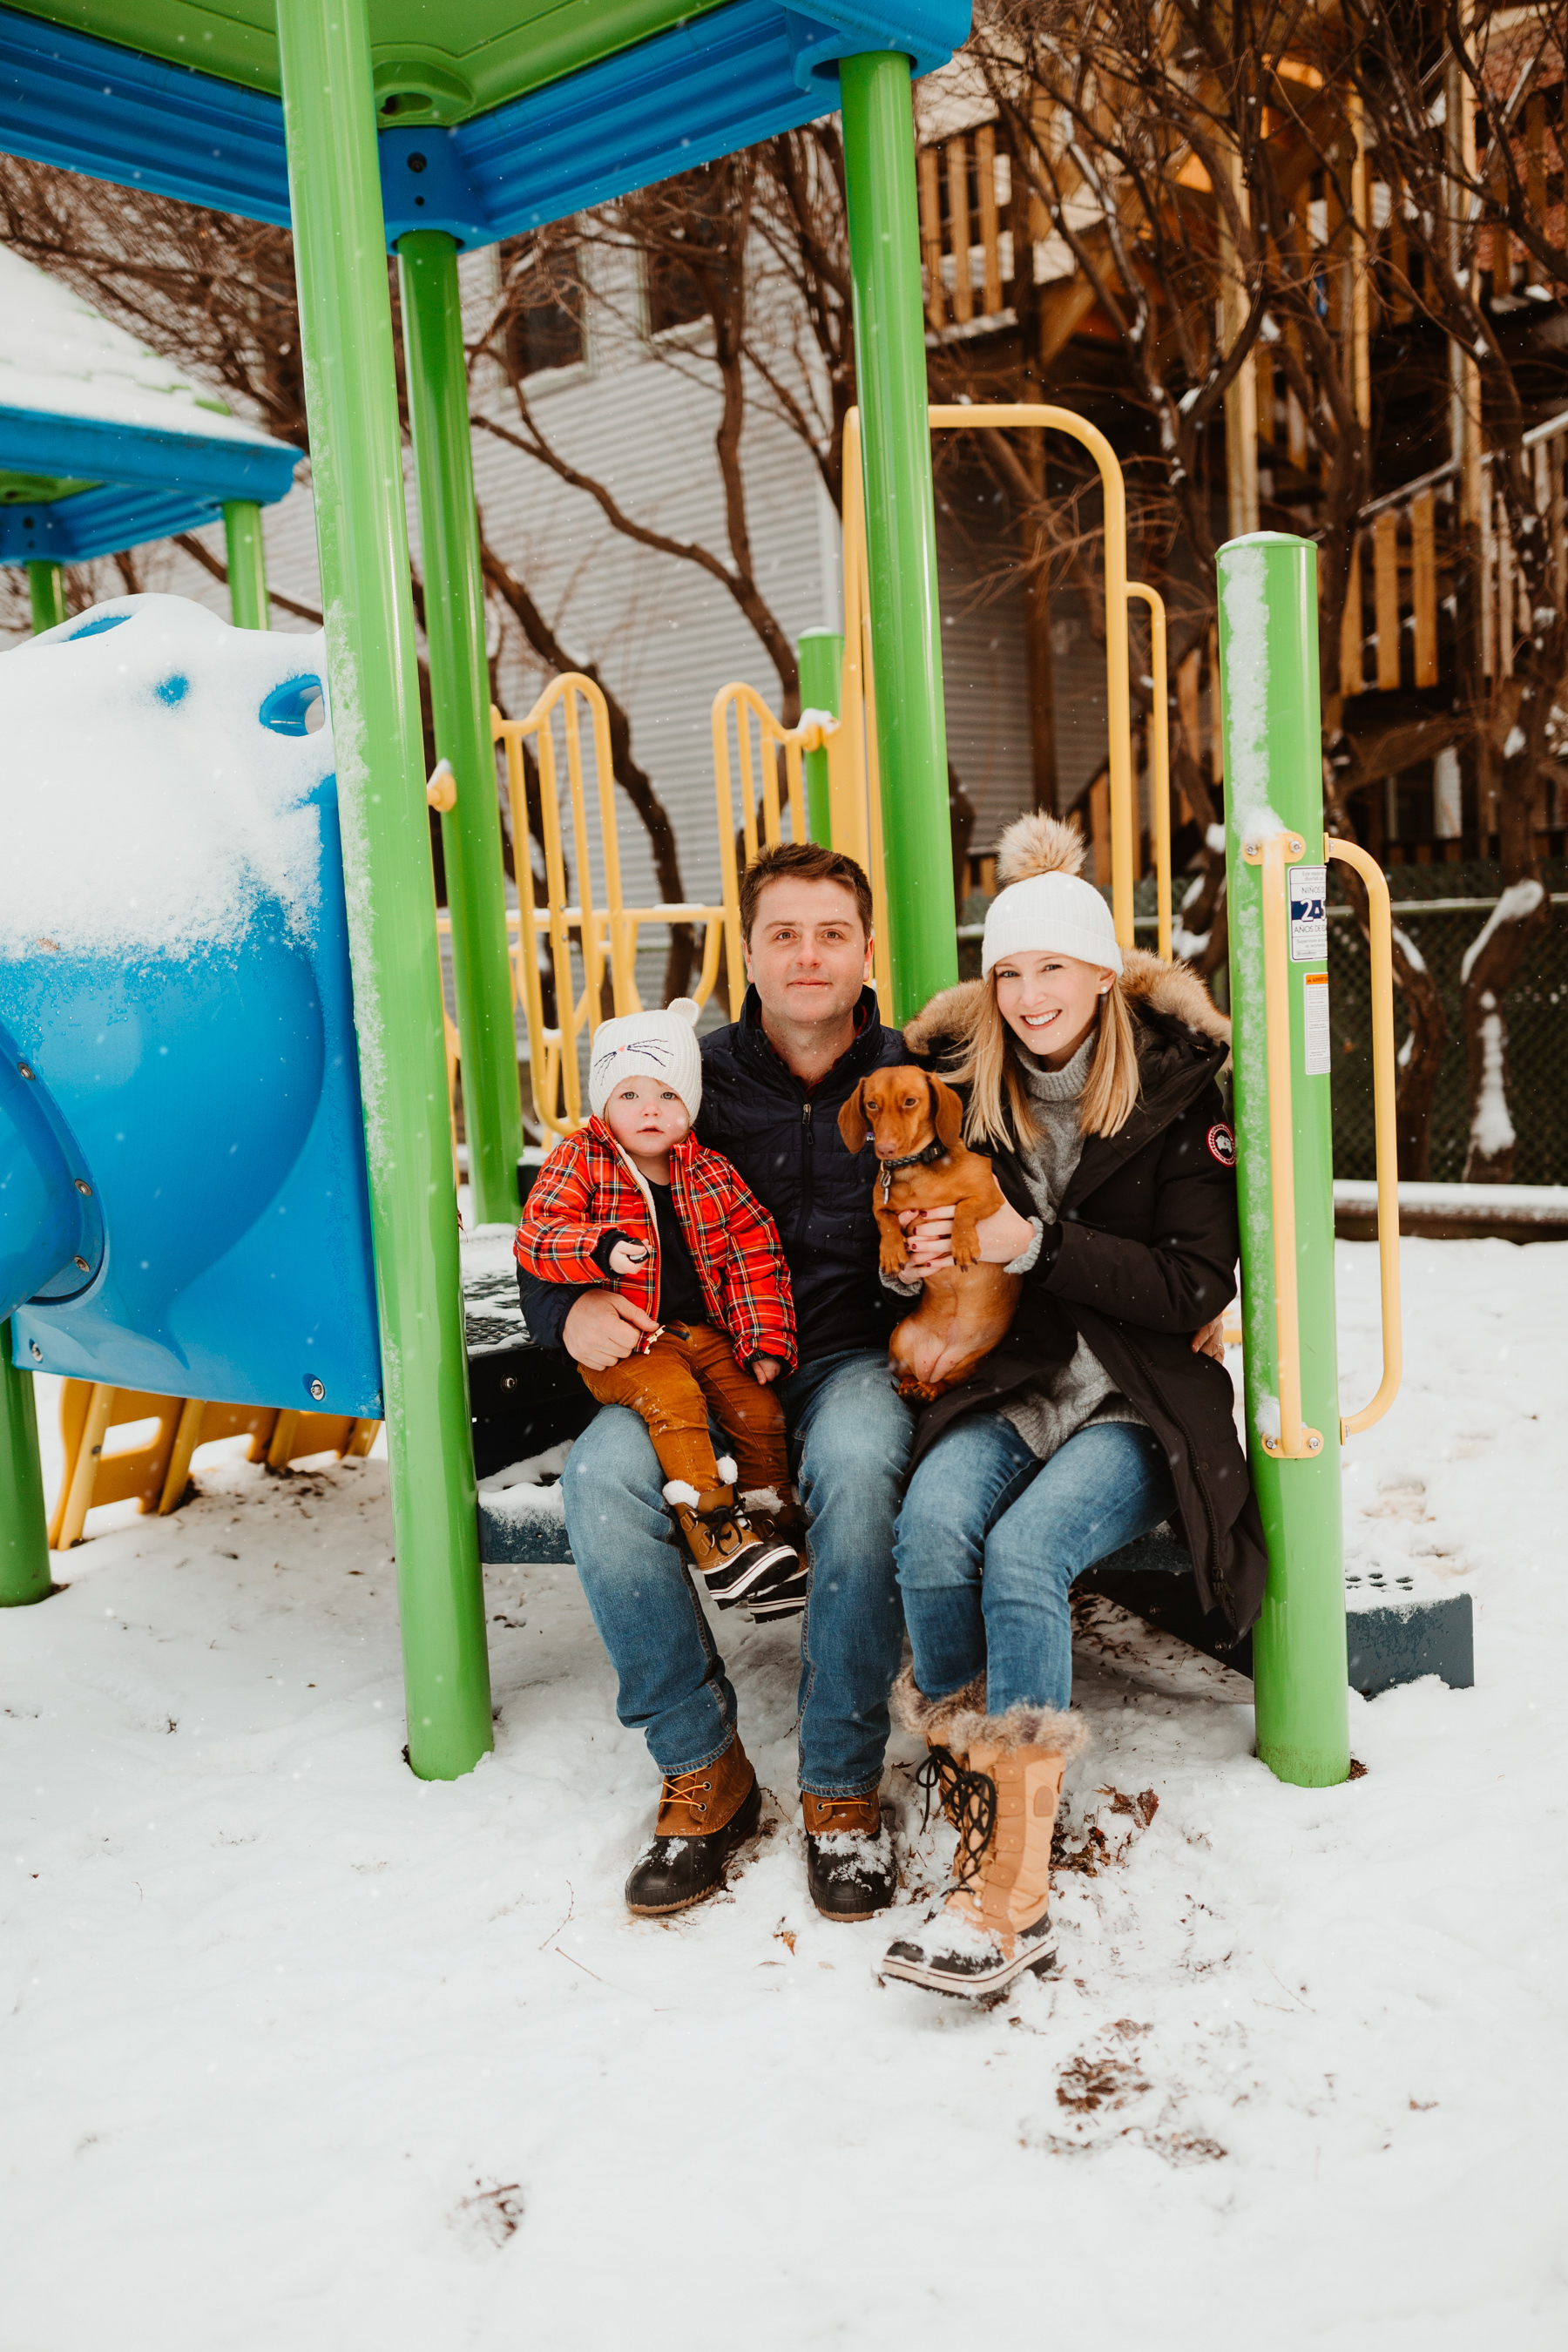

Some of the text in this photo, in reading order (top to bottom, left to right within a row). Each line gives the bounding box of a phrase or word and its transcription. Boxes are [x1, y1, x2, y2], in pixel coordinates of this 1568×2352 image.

[1301, 884, 1321, 895] NIÑOS
[1300, 897, 1314, 923] 2
[1294, 924, 1314, 933] AÑOS
